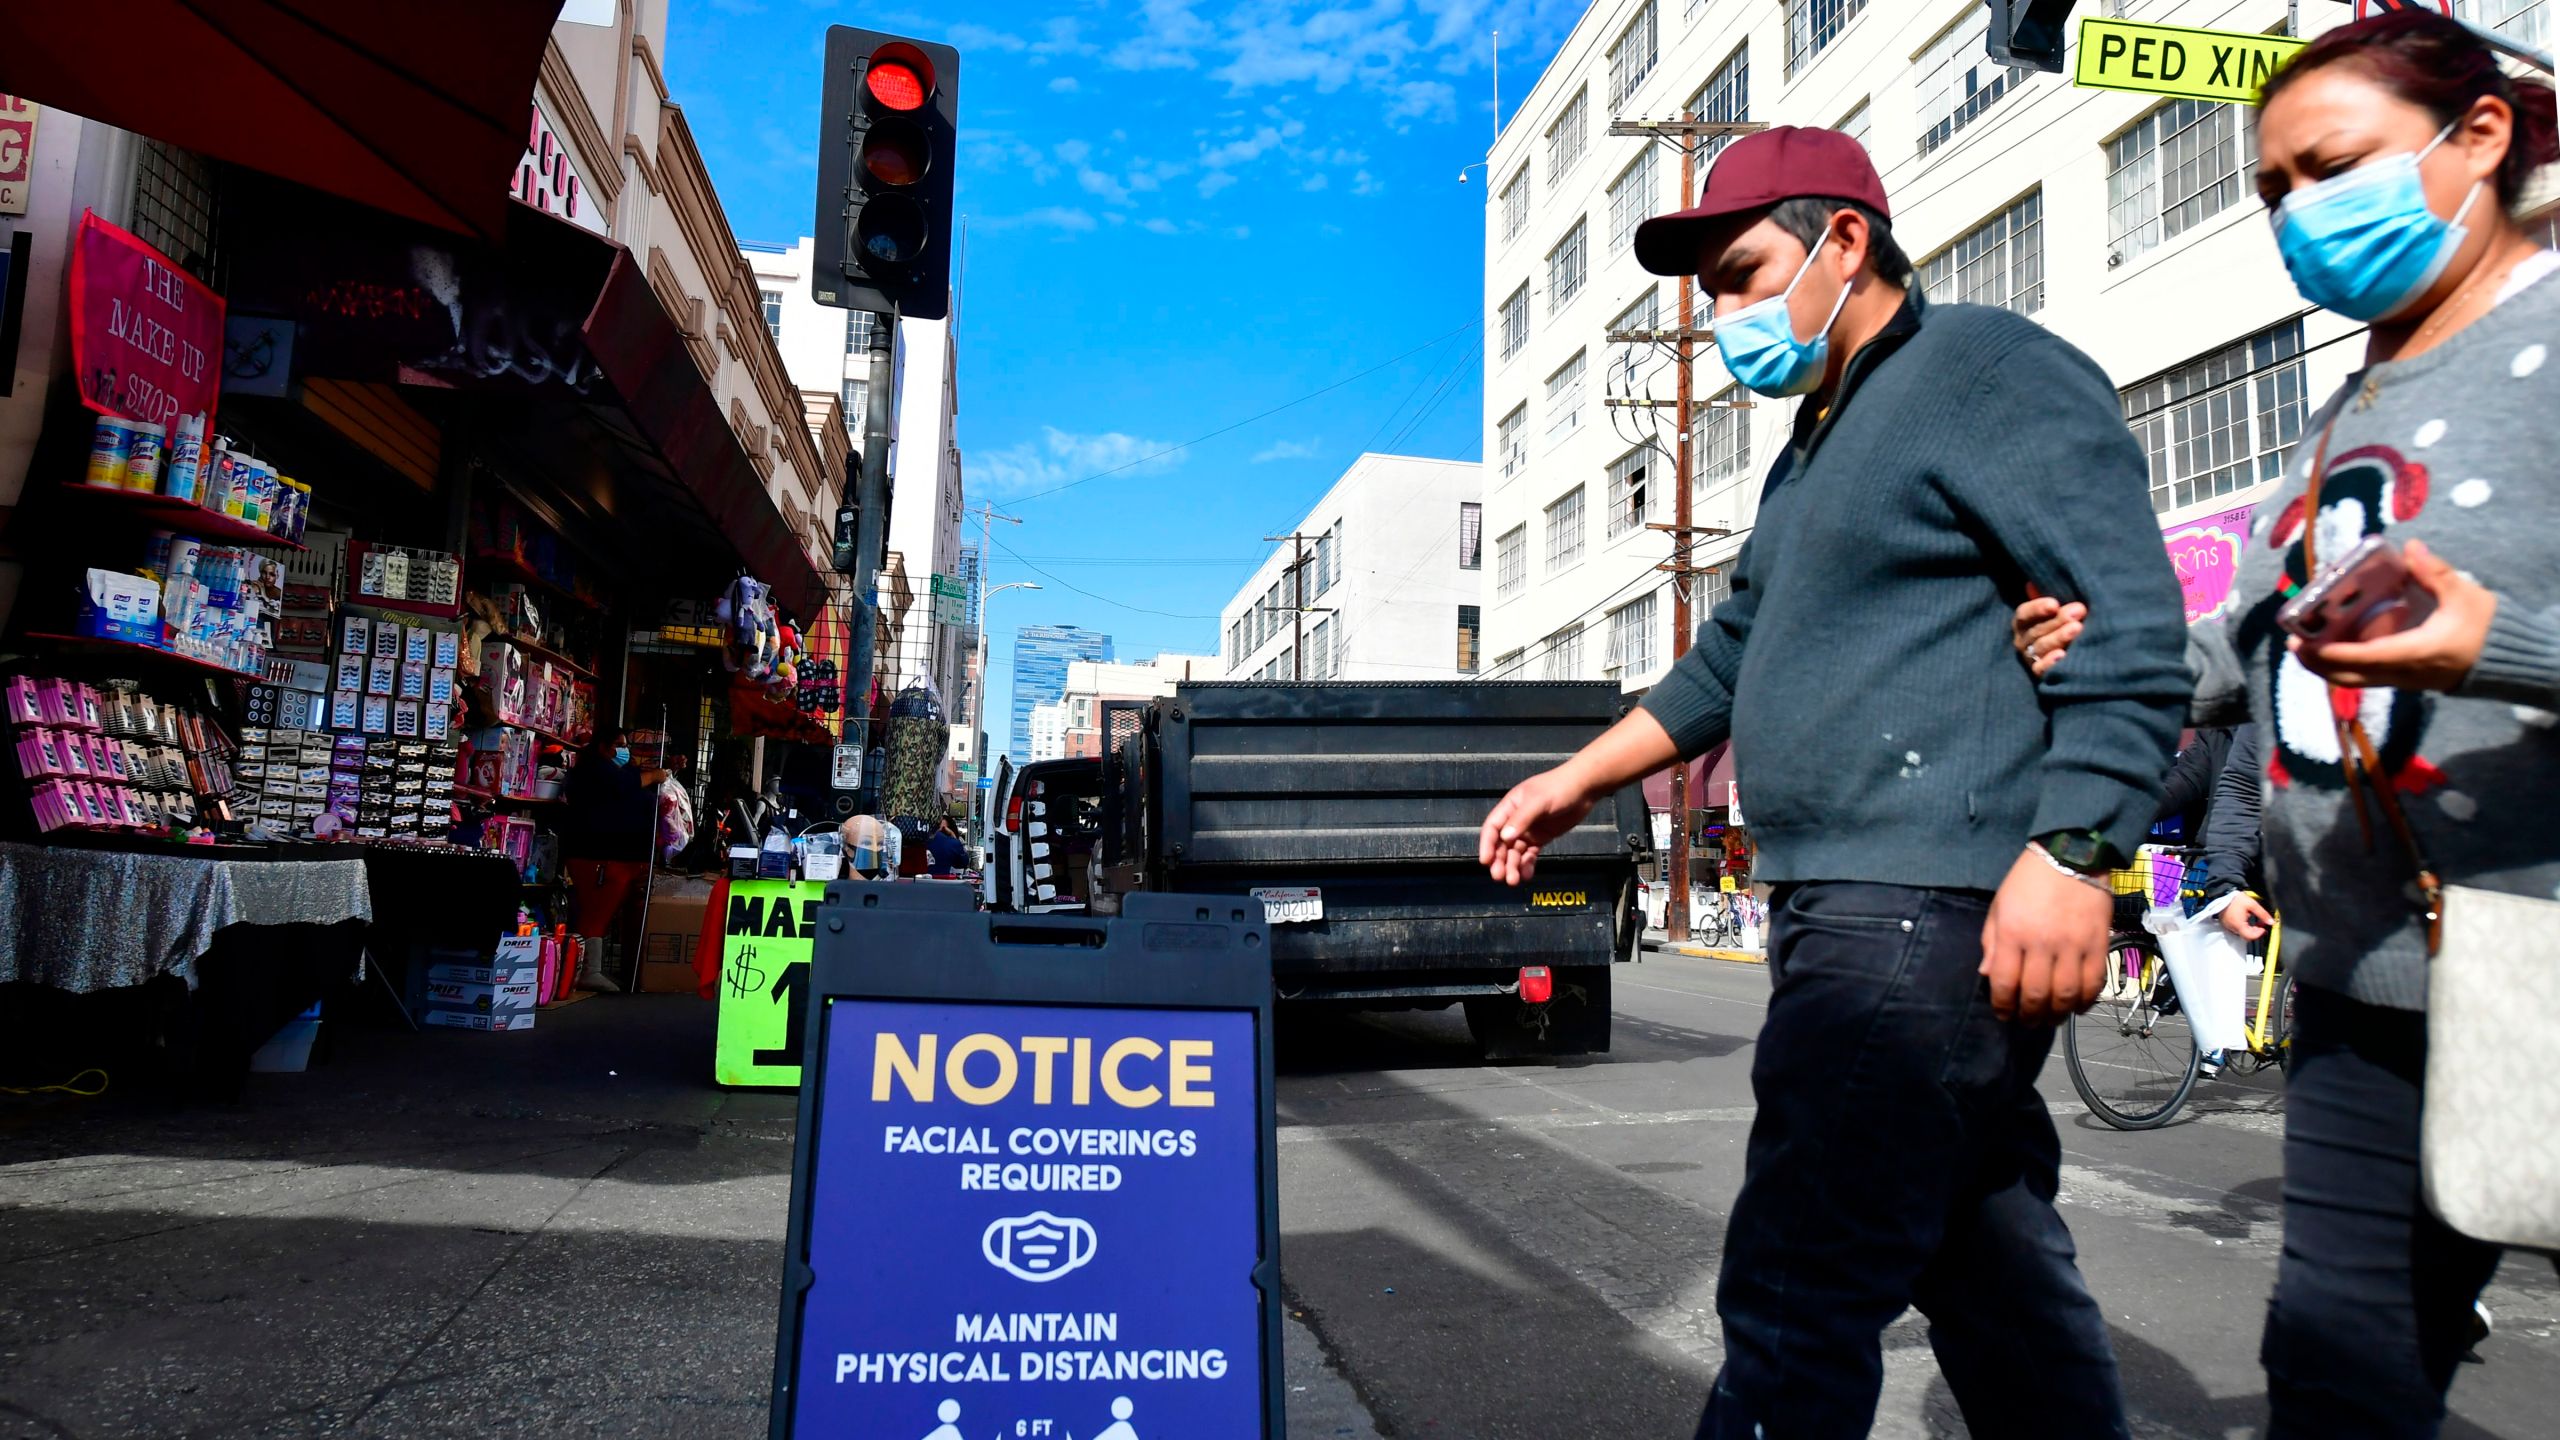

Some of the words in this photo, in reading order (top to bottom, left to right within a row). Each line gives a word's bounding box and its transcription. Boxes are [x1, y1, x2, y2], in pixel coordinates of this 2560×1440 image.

[2098, 34, 2187, 82] PED
[143, 255, 185, 312] THE
[181, 339, 205, 383] UP
[125, 372, 179, 426] SHOP
[943, 582, 966, 595] PARKING
[1532, 891, 1587, 906] MAXON
[871, 1033, 1216, 1109] NOTICE
[884, 1126, 1000, 1155] FACIAL
[1008, 1128, 1197, 1157] COVERINGS
[961, 1162, 1123, 1192] REQUIRED
[955, 1313, 1118, 1343] MAINTAIN
[835, 1352, 1010, 1384] PHYSICAL
[1019, 1349, 1228, 1382] DISTANCING
[1015, 1419, 1027, 1437] 6
[1031, 1419, 1053, 1436] FT
